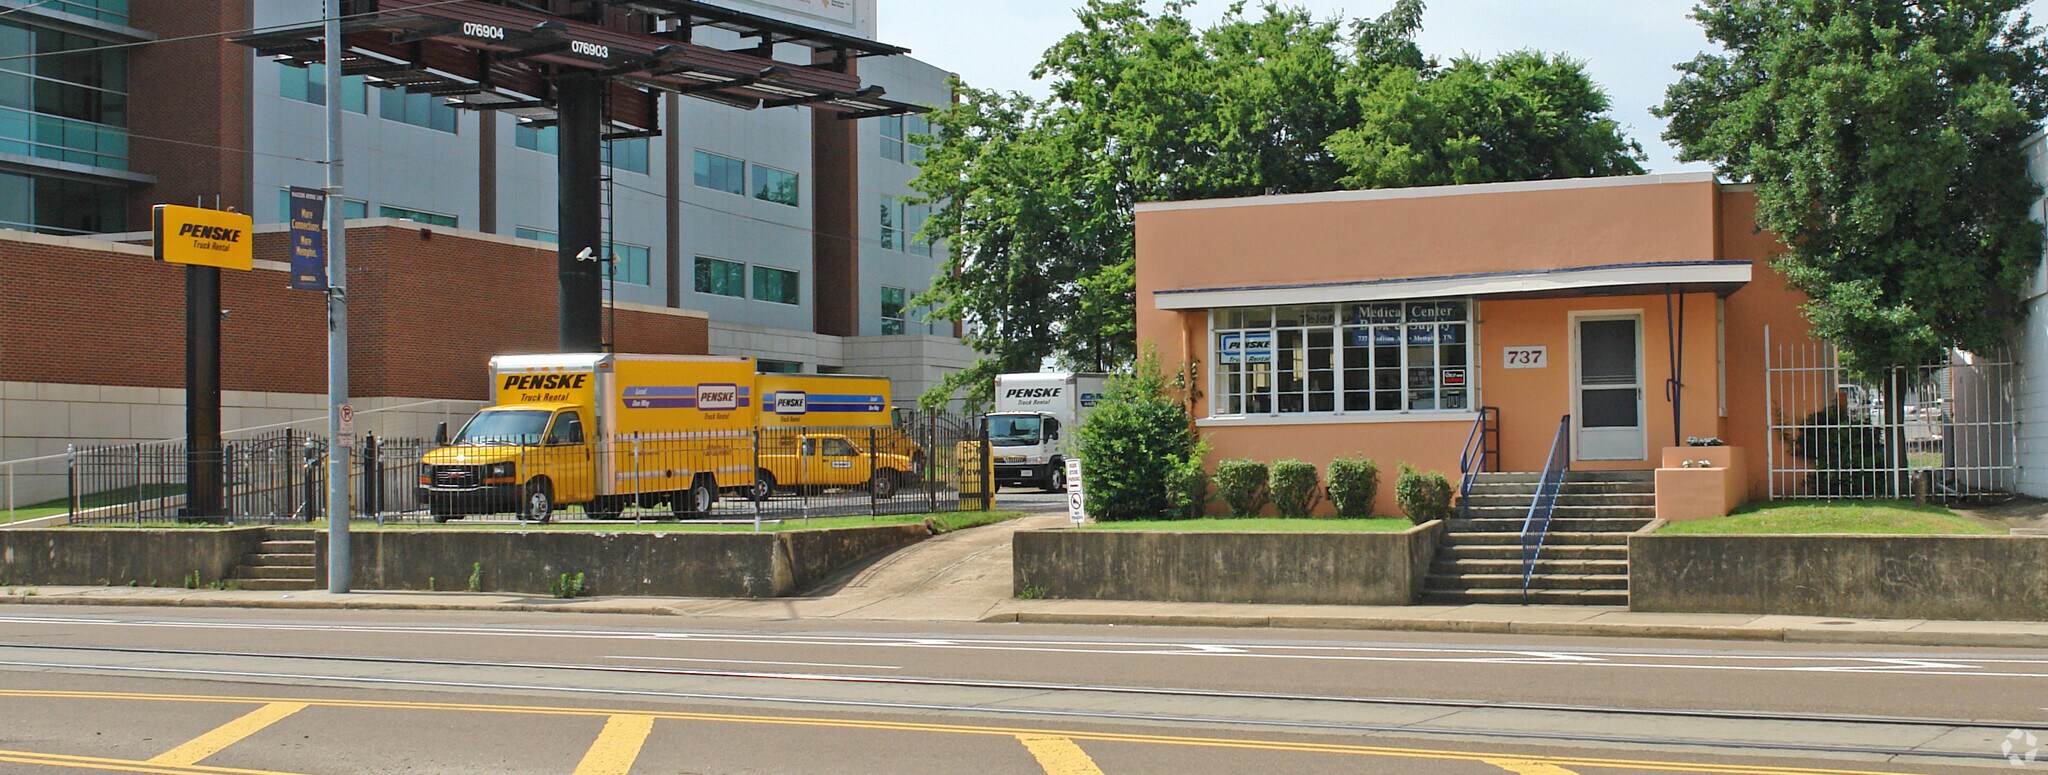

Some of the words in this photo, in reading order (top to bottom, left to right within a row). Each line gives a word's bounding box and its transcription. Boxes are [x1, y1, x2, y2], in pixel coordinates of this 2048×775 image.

[463, 22, 505, 40] 076904
[571, 40, 609, 59] 076903
[301, 208, 313, 219] More
[179, 223, 242, 243] PENSKE
[193, 240, 210, 250] Truck
[212, 242, 231, 252] Rental
[300, 235, 312, 246] More
[1359, 306, 1403, 318] Medica
[1411, 305, 1453, 318] Center
[1508, 350, 1542, 364] 737
[503, 373, 587, 390] PENSKE
[521, 393, 541, 402] Truck
[543, 392, 570, 402] Rental
[700, 391, 734, 402] PENSKE
[1006, 387, 1062, 398] PENSKE
[777, 398, 804, 408] PENSKE
